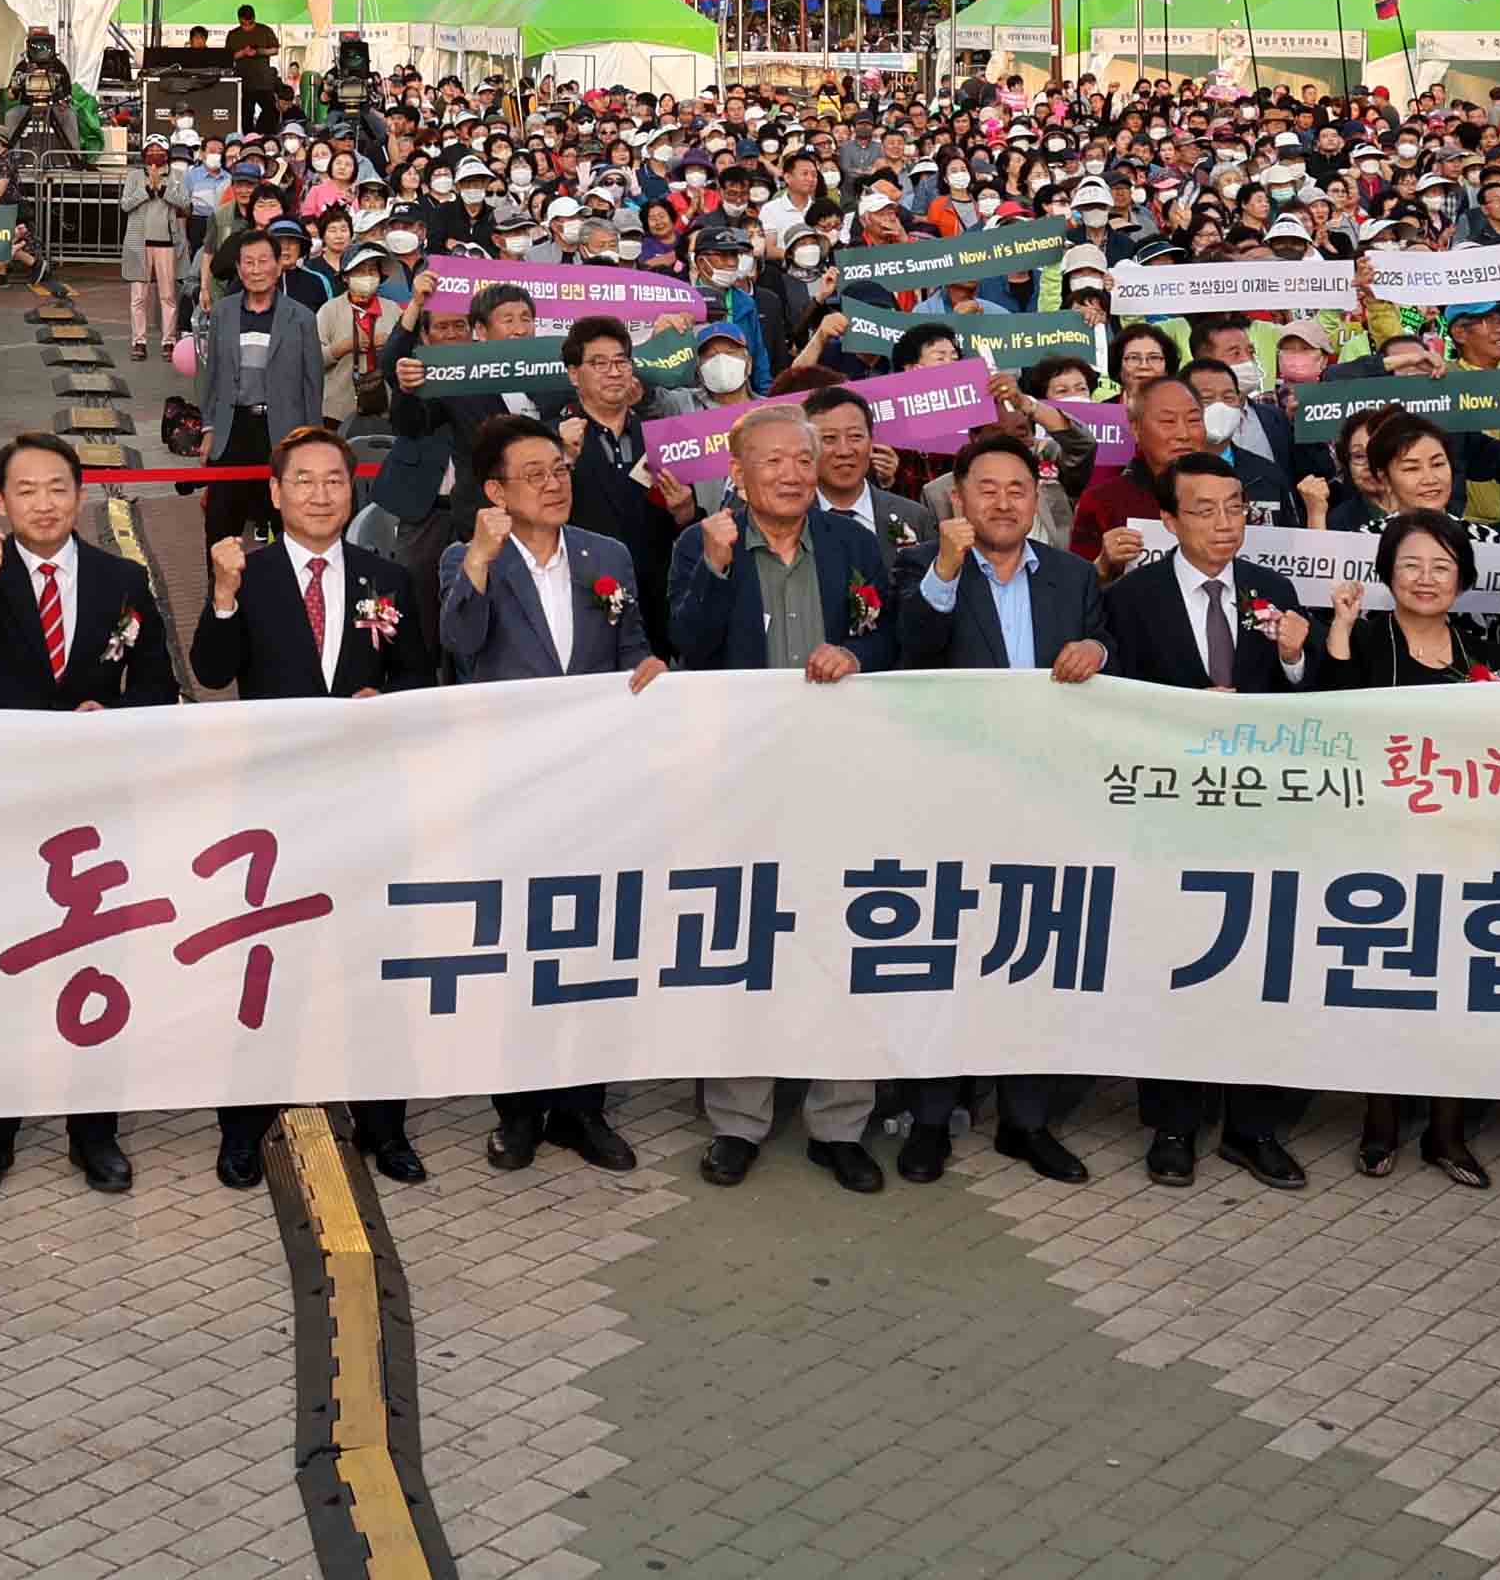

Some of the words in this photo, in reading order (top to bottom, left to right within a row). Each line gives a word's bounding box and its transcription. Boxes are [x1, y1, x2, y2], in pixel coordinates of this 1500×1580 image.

[843, 264, 873, 281] 2025
[873, 259, 904, 277] APEC
[906, 253, 954, 274] Summit
[1012, 234, 1064, 256] Incheon
[436, 276, 470, 295] 2025
[559, 283, 586, 301] 인천
[588, 283, 627, 302] 유치를
[629, 284, 697, 305] 기원합니다.
[1118, 284, 1150, 298] 2025
[1152, 282, 1186, 296] APEC
[1188, 278, 1238, 296] 정상회의
[1240, 278, 1282, 294] 이제는
[1372, 270, 1405, 287] 2025
[1406, 270, 1444, 288] APEC
[1034, 326, 1092, 348] Incheon
[425, 361, 467, 381] 2025
[469, 361, 511, 380] APEC
[896, 385, 981, 421] 기원합니다.
[1303, 399, 1344, 421] 2025
[658, 441, 701, 464] 2025
[1257, 554, 1337, 582] 정상회의
[1103, 763, 1180, 806] 살고
[1190, 764, 1269, 808] 싶은
[1276, 762, 1367, 808] 도시!
[379, 861, 799, 1017] 구민과
[842, 859, 1117, 996] 함께
